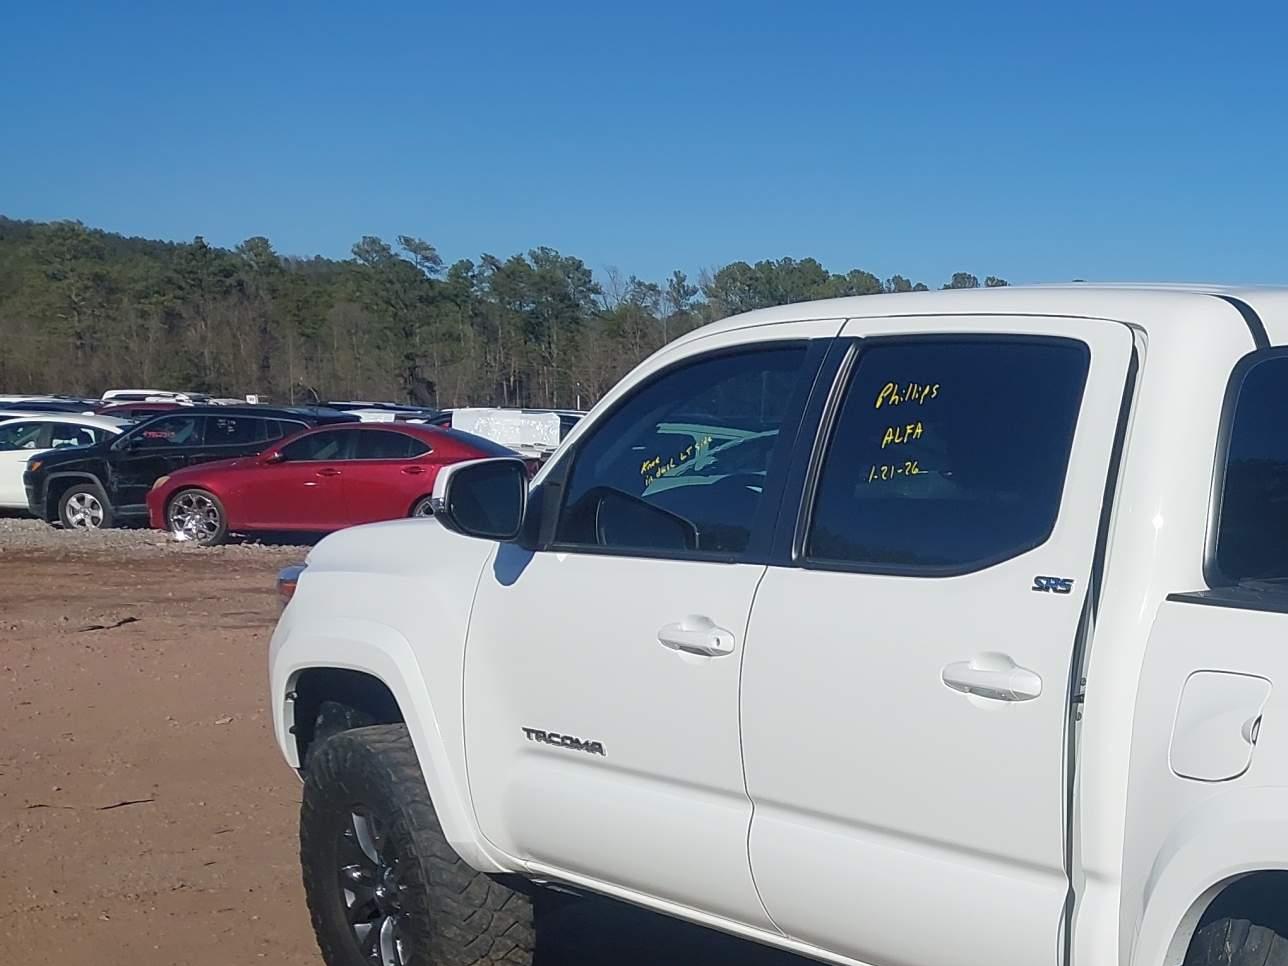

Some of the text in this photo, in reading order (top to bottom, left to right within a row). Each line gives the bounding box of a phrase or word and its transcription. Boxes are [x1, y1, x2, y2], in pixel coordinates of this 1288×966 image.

[875, 382, 940, 409] Phillips
[881, 422, 924, 449] ALFA
[521, 726, 607, 757] TACOMA
